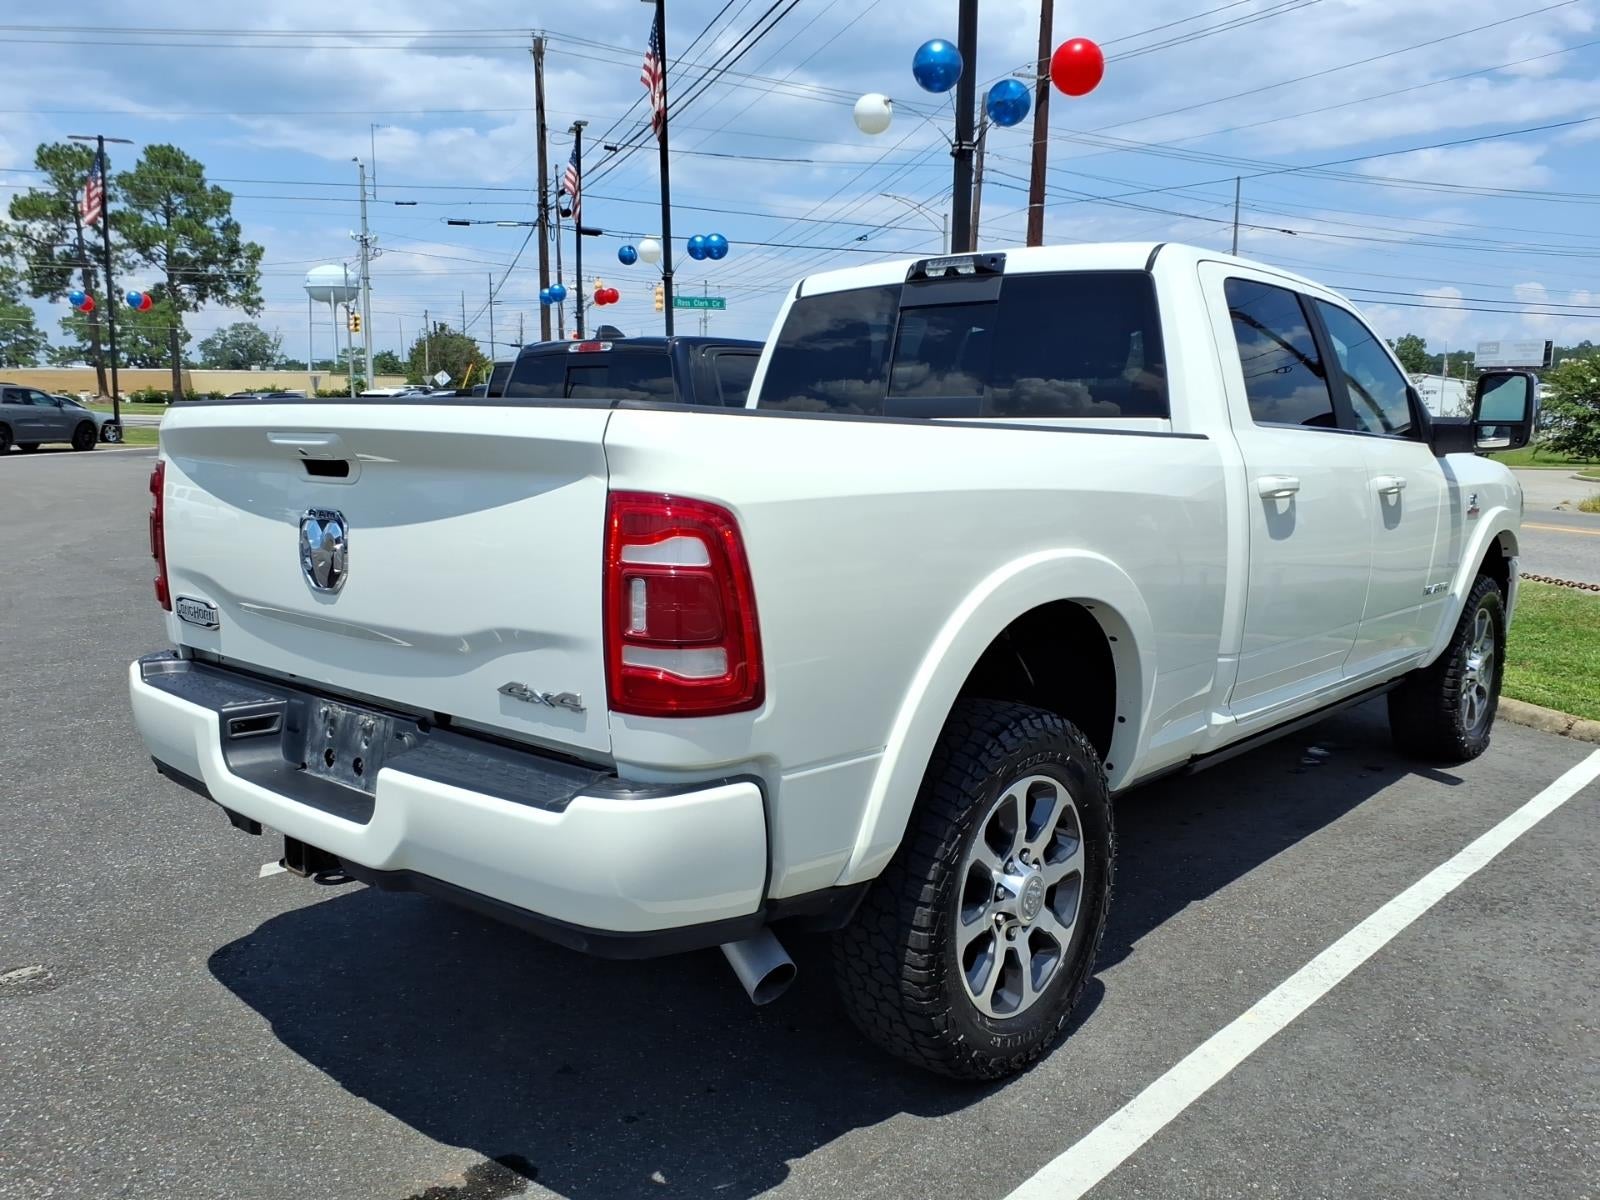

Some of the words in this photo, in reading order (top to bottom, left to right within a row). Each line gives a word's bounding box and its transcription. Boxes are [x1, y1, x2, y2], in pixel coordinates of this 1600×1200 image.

[677, 298, 691, 307] Ross
[693, 298, 709, 307] Clark
[308, 508, 336, 519] RAM
[176, 603, 215, 622] LONGHORN
